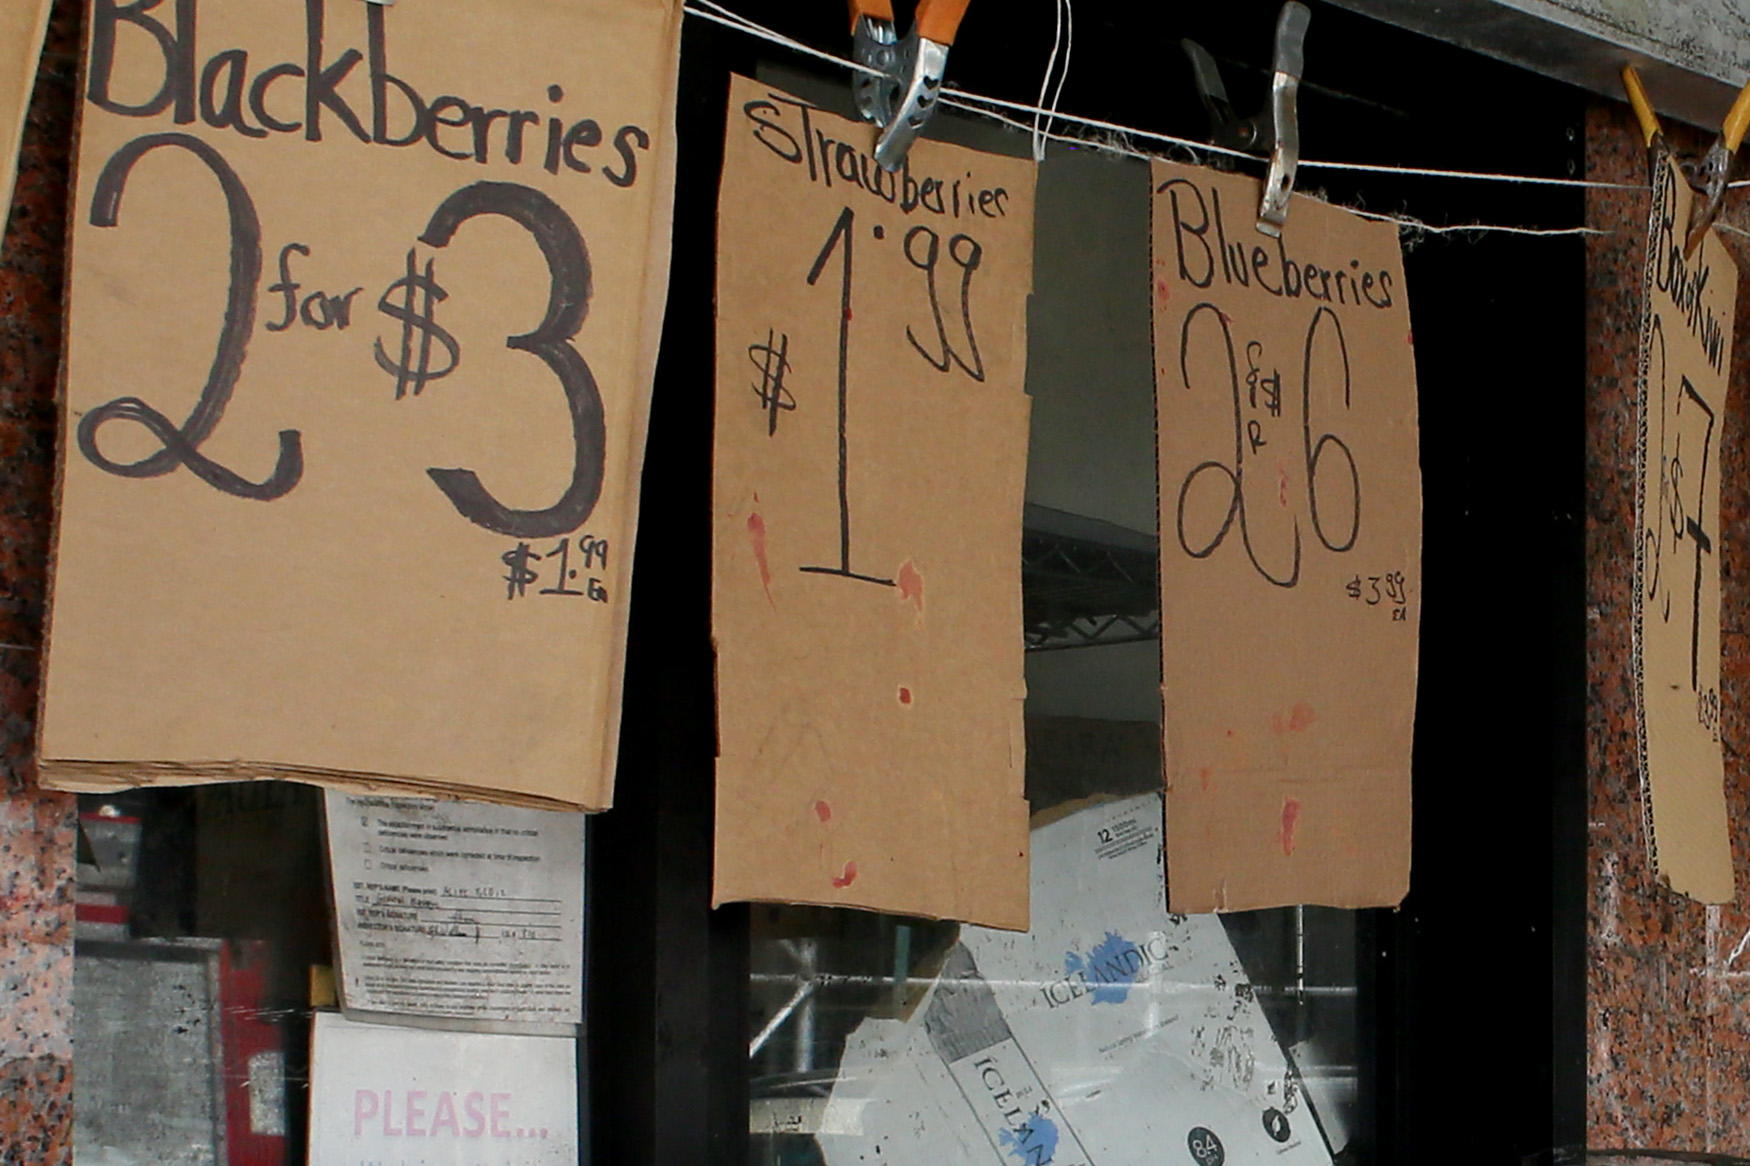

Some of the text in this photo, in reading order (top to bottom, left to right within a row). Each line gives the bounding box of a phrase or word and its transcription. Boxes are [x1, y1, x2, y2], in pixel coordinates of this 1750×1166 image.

[87, 0, 650, 187] Blackberries
[77, 132, 304, 502] 2
[266, 243, 364, 332] for
[1156, 177, 1394, 309] Blueberries
[354, 1089, 550, 1139] PLEASE...
